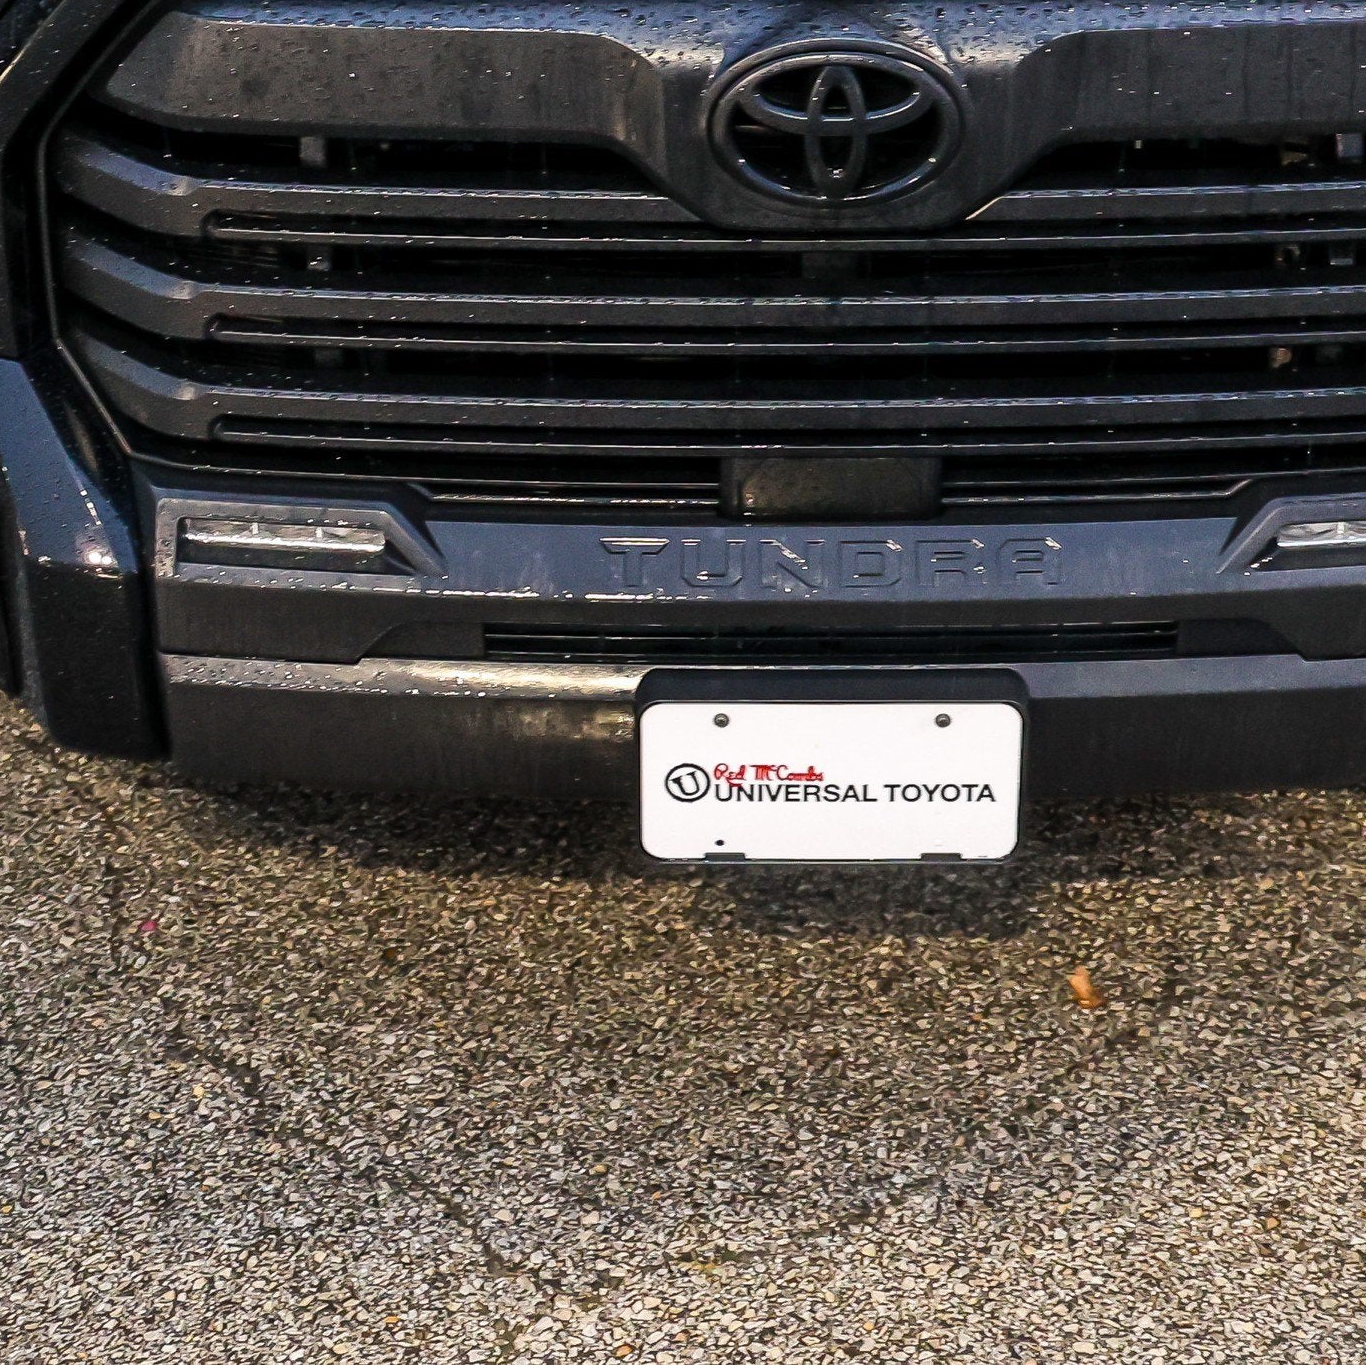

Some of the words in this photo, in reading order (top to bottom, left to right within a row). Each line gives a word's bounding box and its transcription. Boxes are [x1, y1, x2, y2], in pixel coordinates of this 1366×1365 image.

[598, 536, 1065, 589] TUNDRA
[713, 762, 746, 787] Red
[714, 783, 877, 803] UNIVERSAL
[884, 783, 996, 803] TOYOTA
